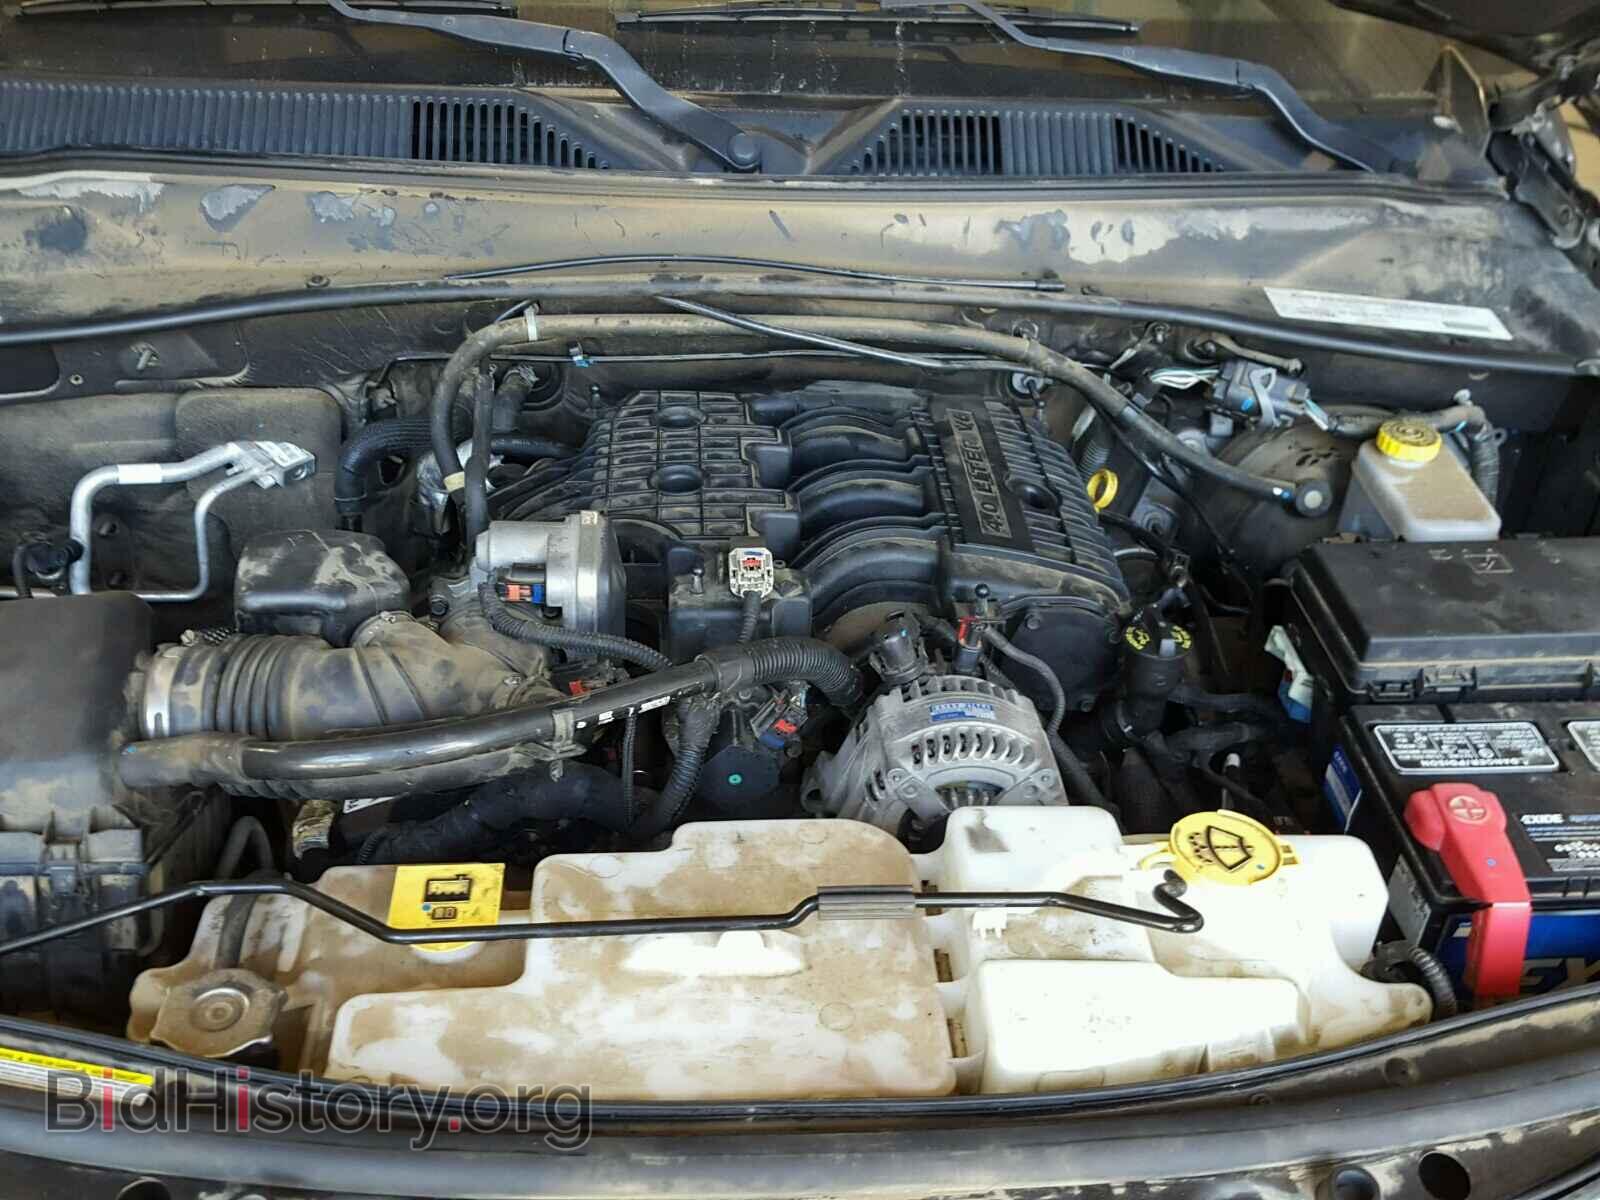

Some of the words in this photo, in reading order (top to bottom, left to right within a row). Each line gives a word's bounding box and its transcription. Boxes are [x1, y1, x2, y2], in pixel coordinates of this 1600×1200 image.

[953, 412, 973, 432] V6
[962, 441, 995, 496] LITER
[980, 501, 1003, 533] 4.0
